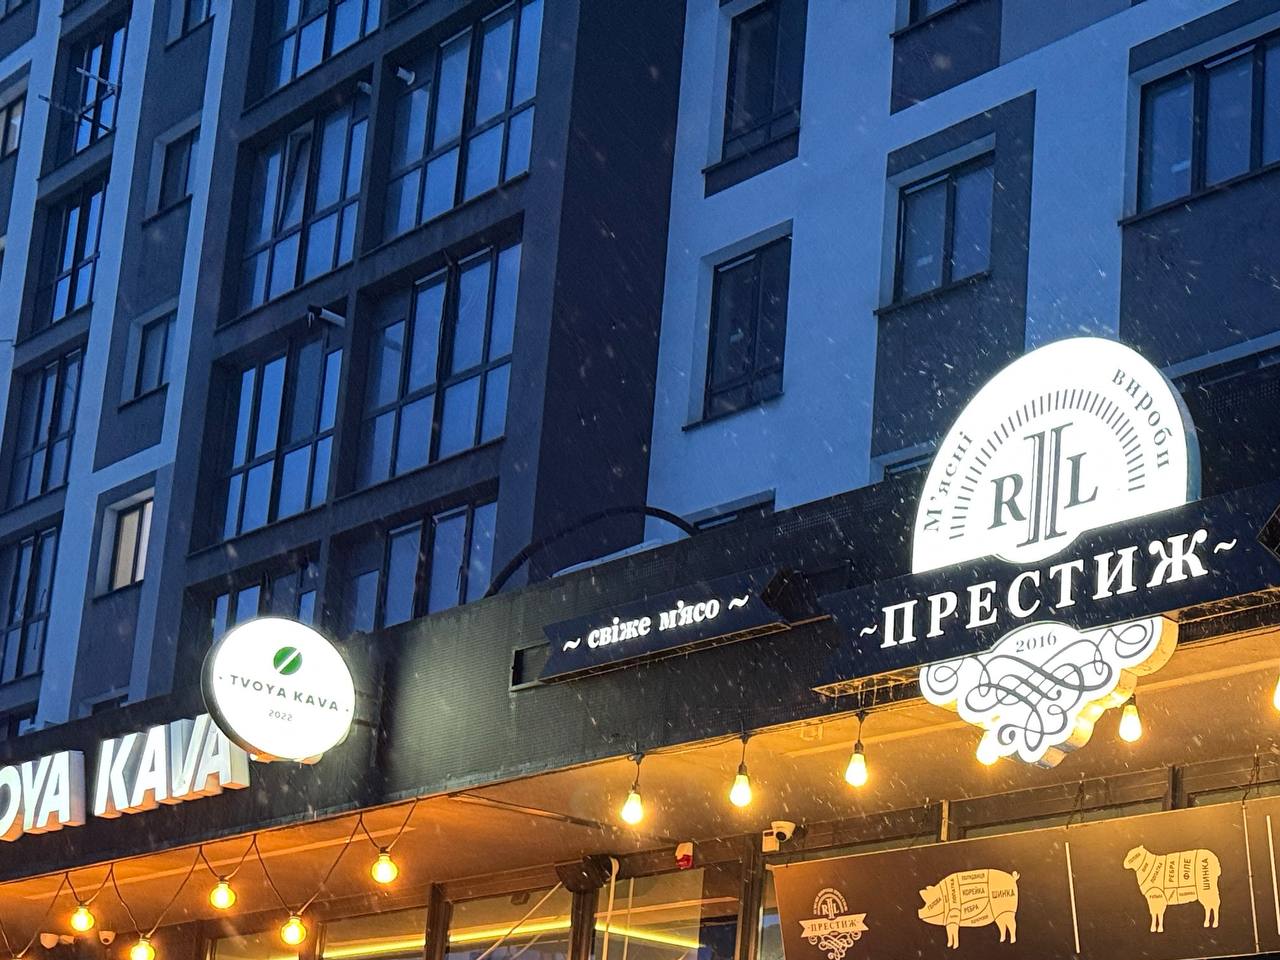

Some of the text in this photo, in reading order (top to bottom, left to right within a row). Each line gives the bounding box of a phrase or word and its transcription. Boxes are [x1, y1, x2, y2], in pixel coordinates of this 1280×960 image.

[880, 529, 1209, 649] ПРЕСТИЖ
[587, 598, 720, 650] свіже м'ясо
[1016, 631, 1057, 653] 2016
[230, 674, 339, 712] TVOYA KAVA
[268, 709, 293, 722] 2022
[94, 712, 242, 819] KAVA
[1168, 860, 1176, 883] РЕБРА
[1201, 857, 1211, 891] ШИНКА
[991, 888, 1016, 899] ШИНКА
[811, 919, 857, 932] ПРЕСТИЖ
